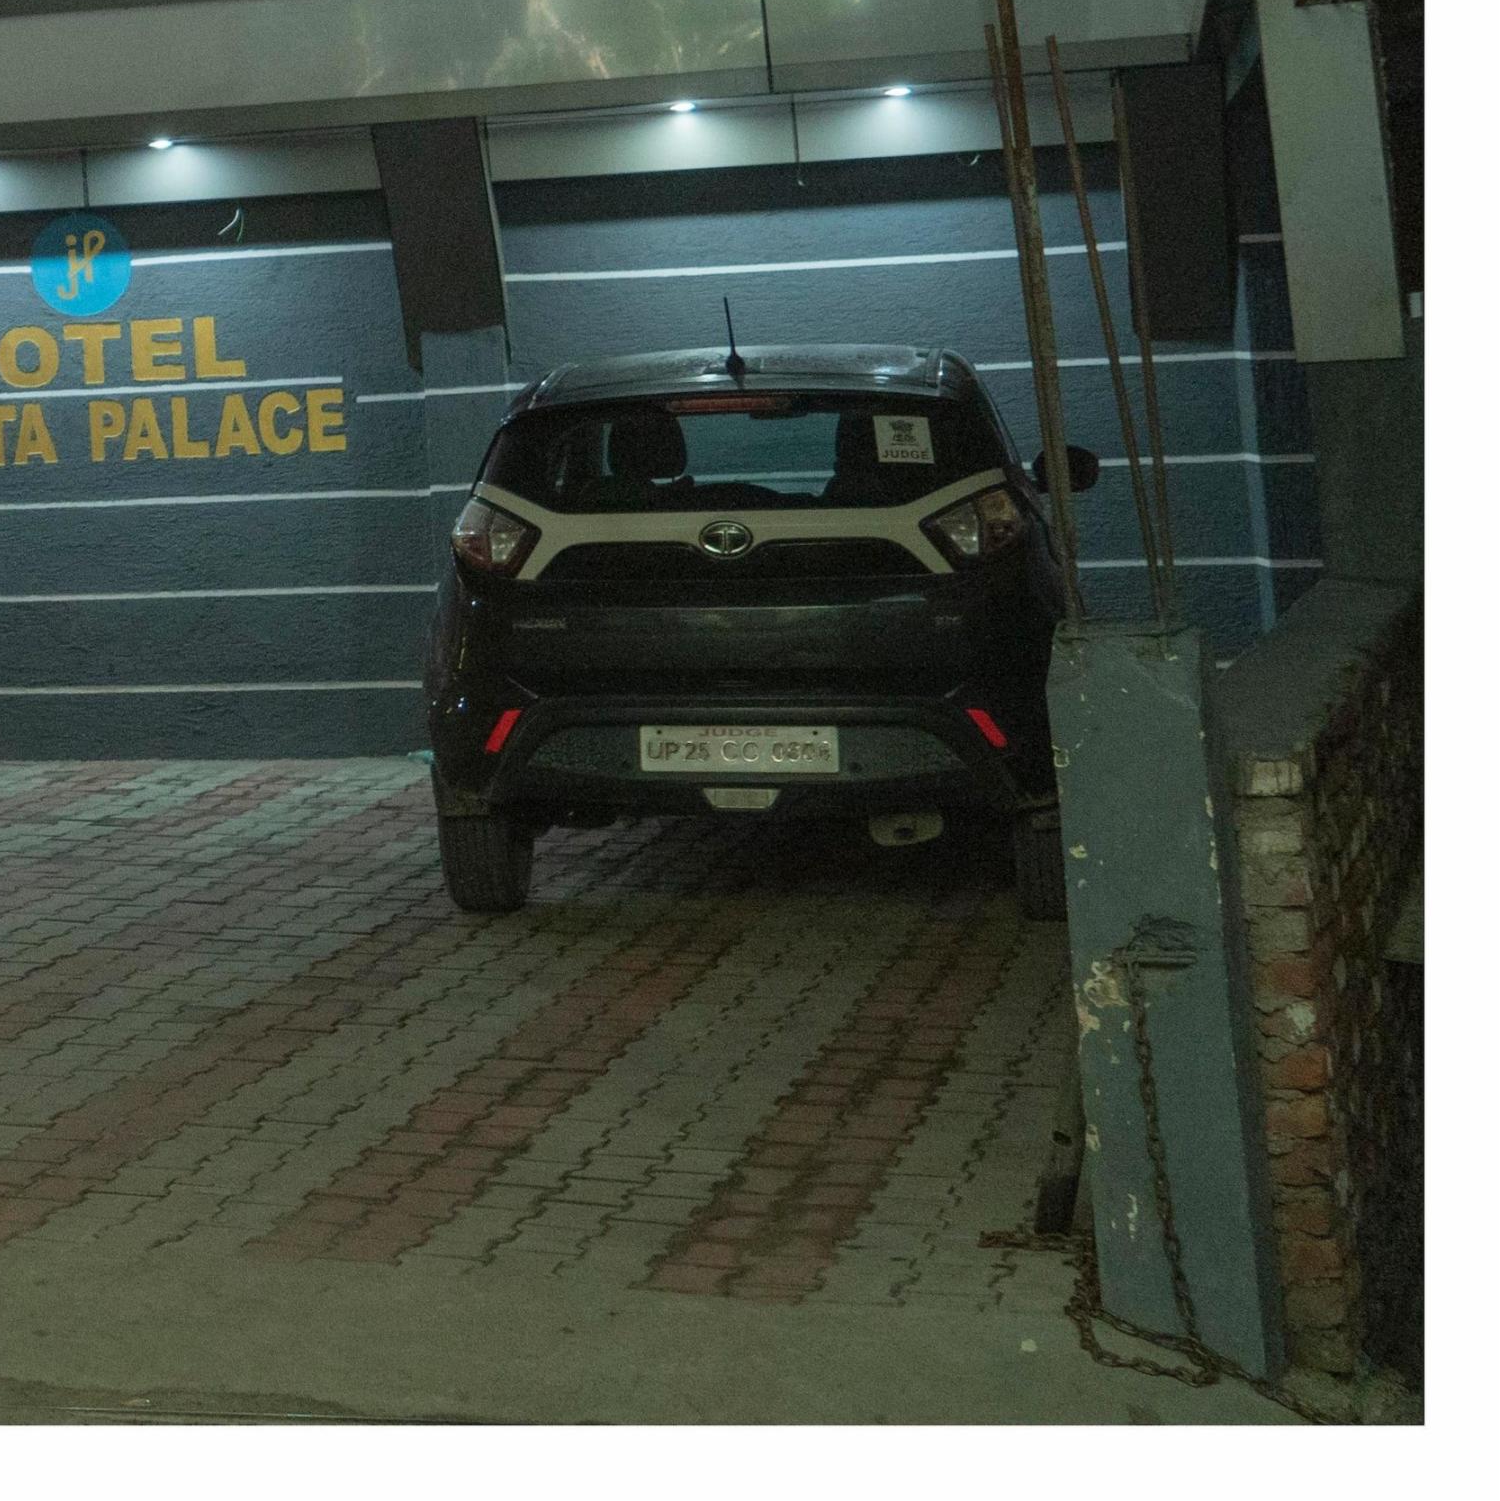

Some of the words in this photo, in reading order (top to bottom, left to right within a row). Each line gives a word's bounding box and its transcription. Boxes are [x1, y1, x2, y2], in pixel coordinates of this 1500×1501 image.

[88, 389, 347, 462] PALACE
[882, 449, 931, 460] JUDGE
[698, 728, 778, 738] JUDGE
[720, 740, 760, 762] CC
